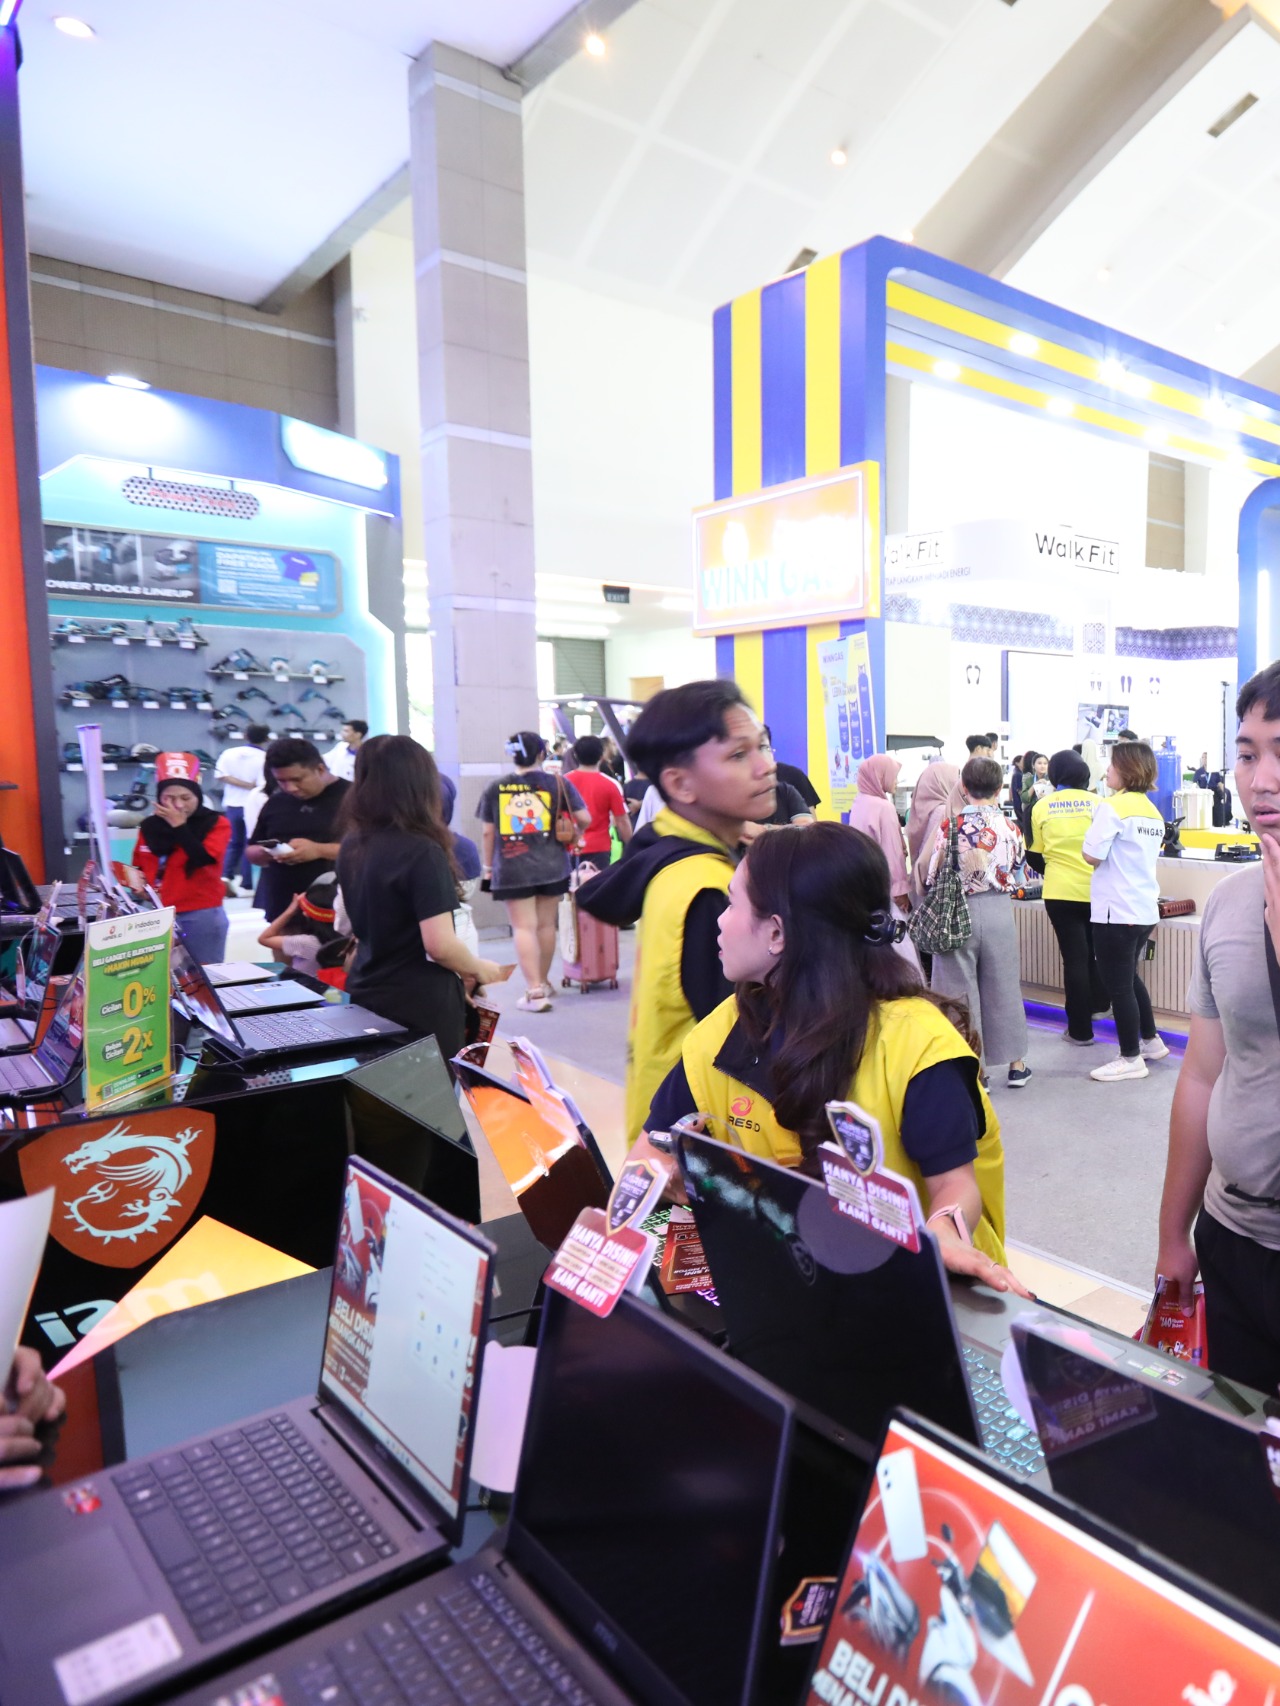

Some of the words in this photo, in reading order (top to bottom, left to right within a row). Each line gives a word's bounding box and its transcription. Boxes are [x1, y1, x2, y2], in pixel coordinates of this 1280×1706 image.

[45, 579, 92, 591] OWER
[95, 582, 142, 595] TOOLS
[143, 586, 194, 599] LINEUP
[701, 560, 769, 610] WINN
[1048, 801, 1072, 810] WINN
[1073, 800, 1091, 808] GAS
[101, 1002, 123, 1015] Cicilan
[123, 981, 156, 1018] 0%
[822, 1160, 866, 1191] HANYA
[569, 1223, 606, 1252] HANYA
[838, 1200, 871, 1225] KAMI
[871, 1217, 908, 1245] GANTI
[551, 1267, 579, 1291] KAMI
[575, 1279, 609, 1308] GANTI
[334, 1295, 355, 1328] BELI
[828, 1637, 889, 1706] BELI
